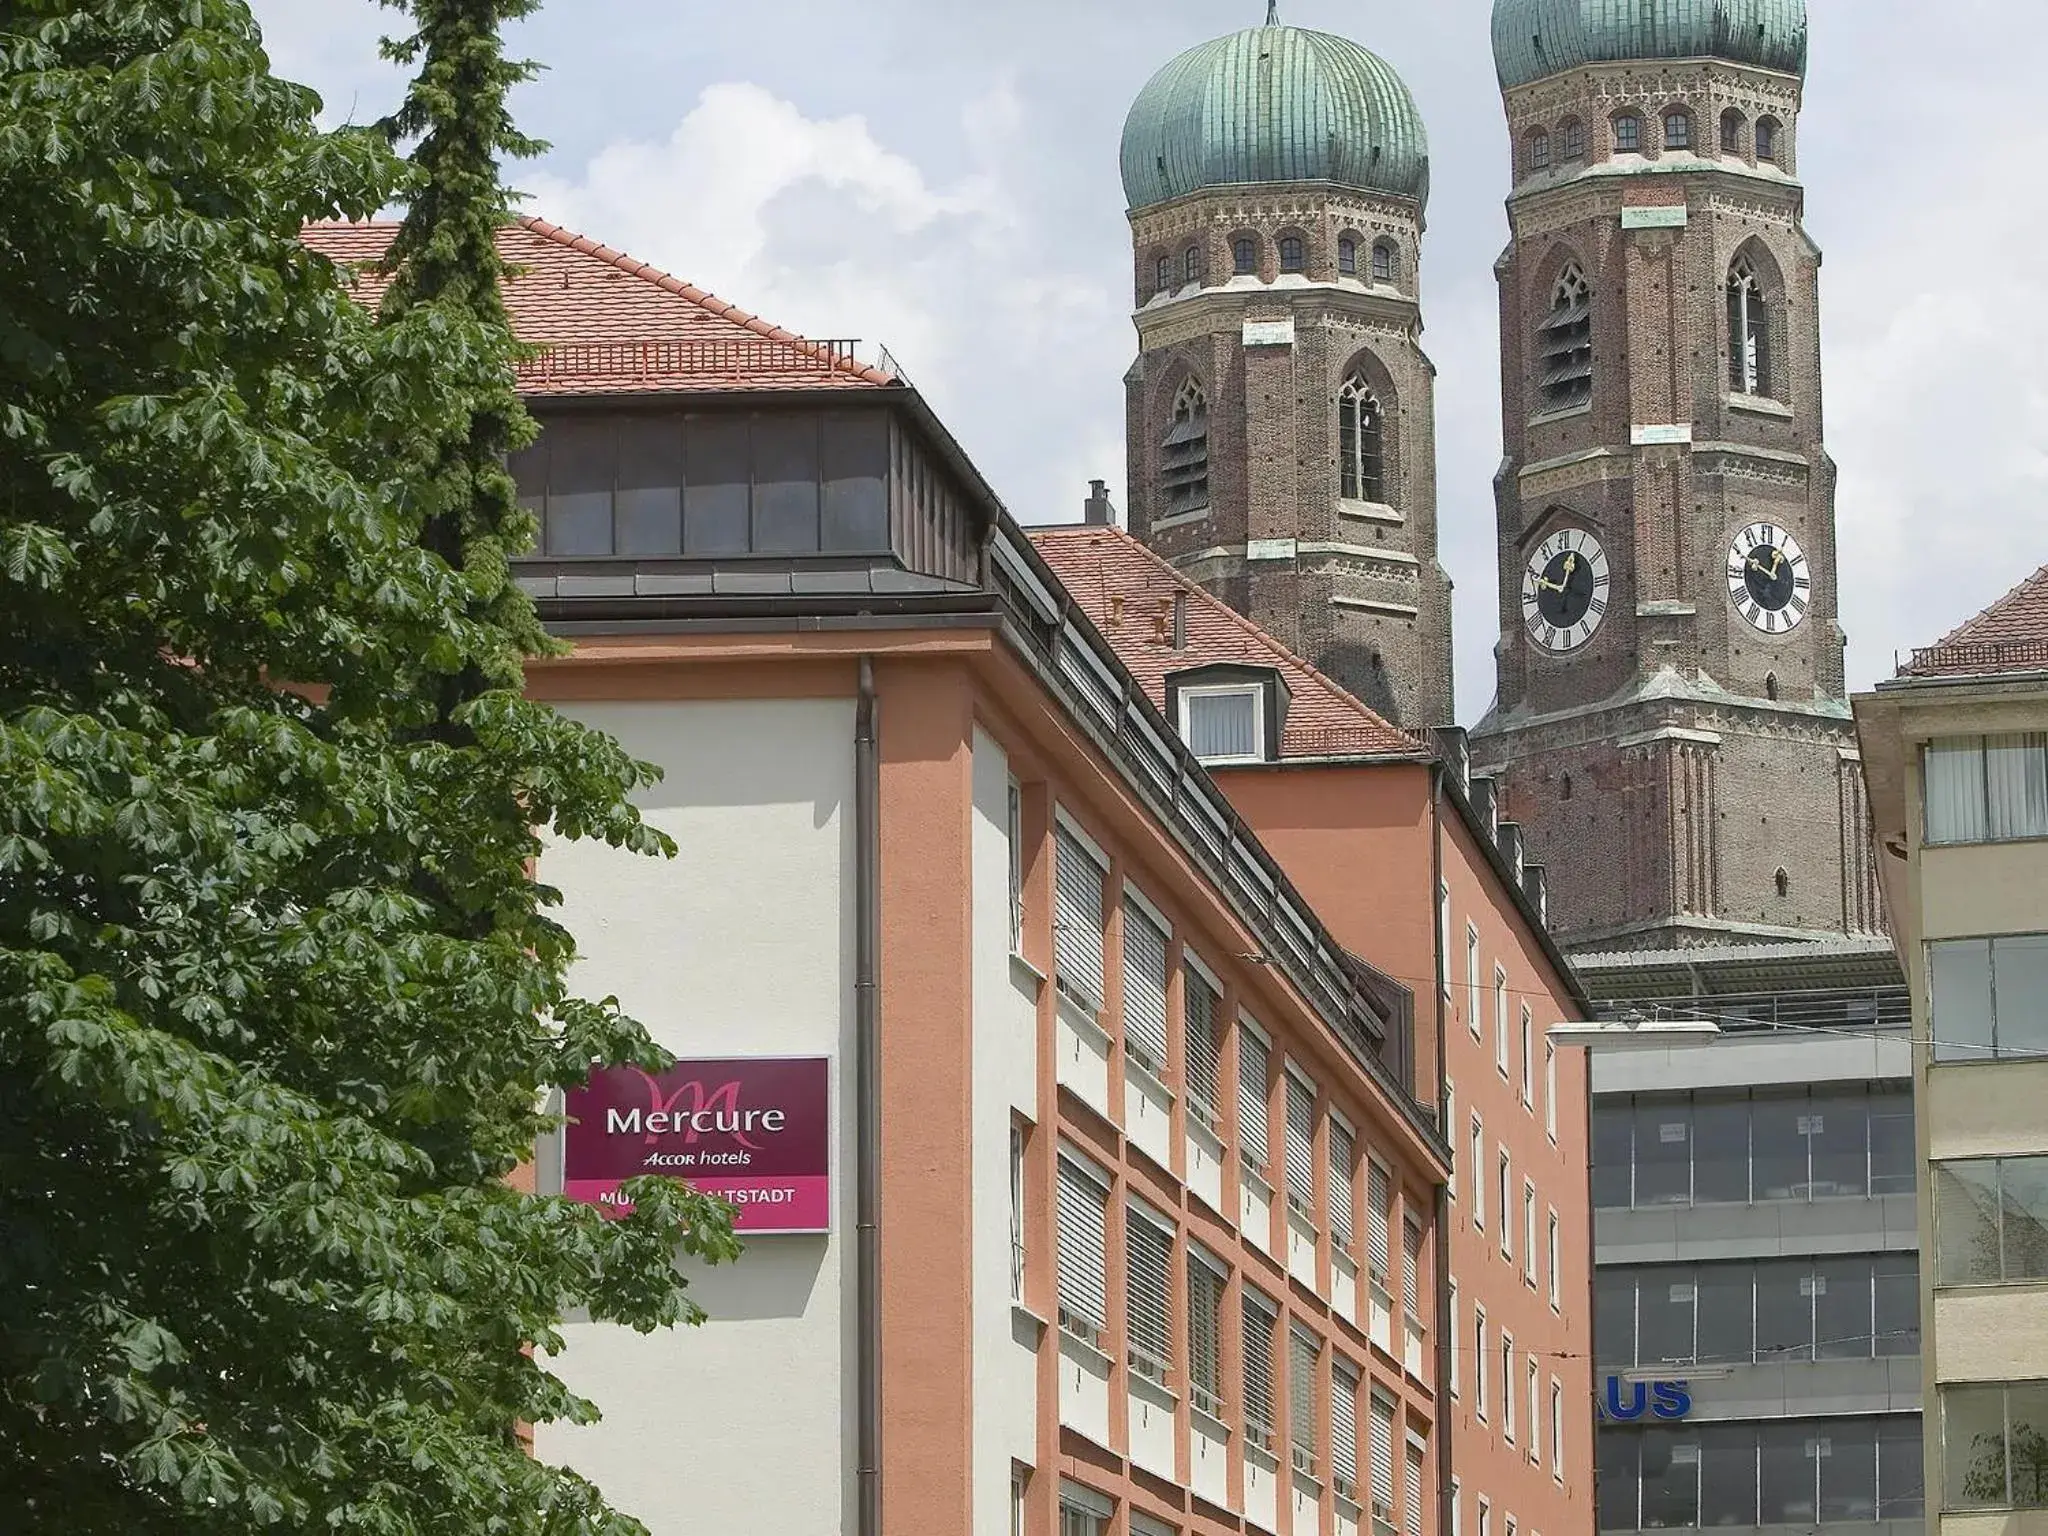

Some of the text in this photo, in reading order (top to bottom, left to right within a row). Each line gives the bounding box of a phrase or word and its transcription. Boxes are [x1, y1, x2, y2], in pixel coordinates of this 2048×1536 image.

[607, 1107, 786, 1134] Mercure
[699, 1150, 752, 1165] hotels
[1597, 1375, 1693, 1420] US
